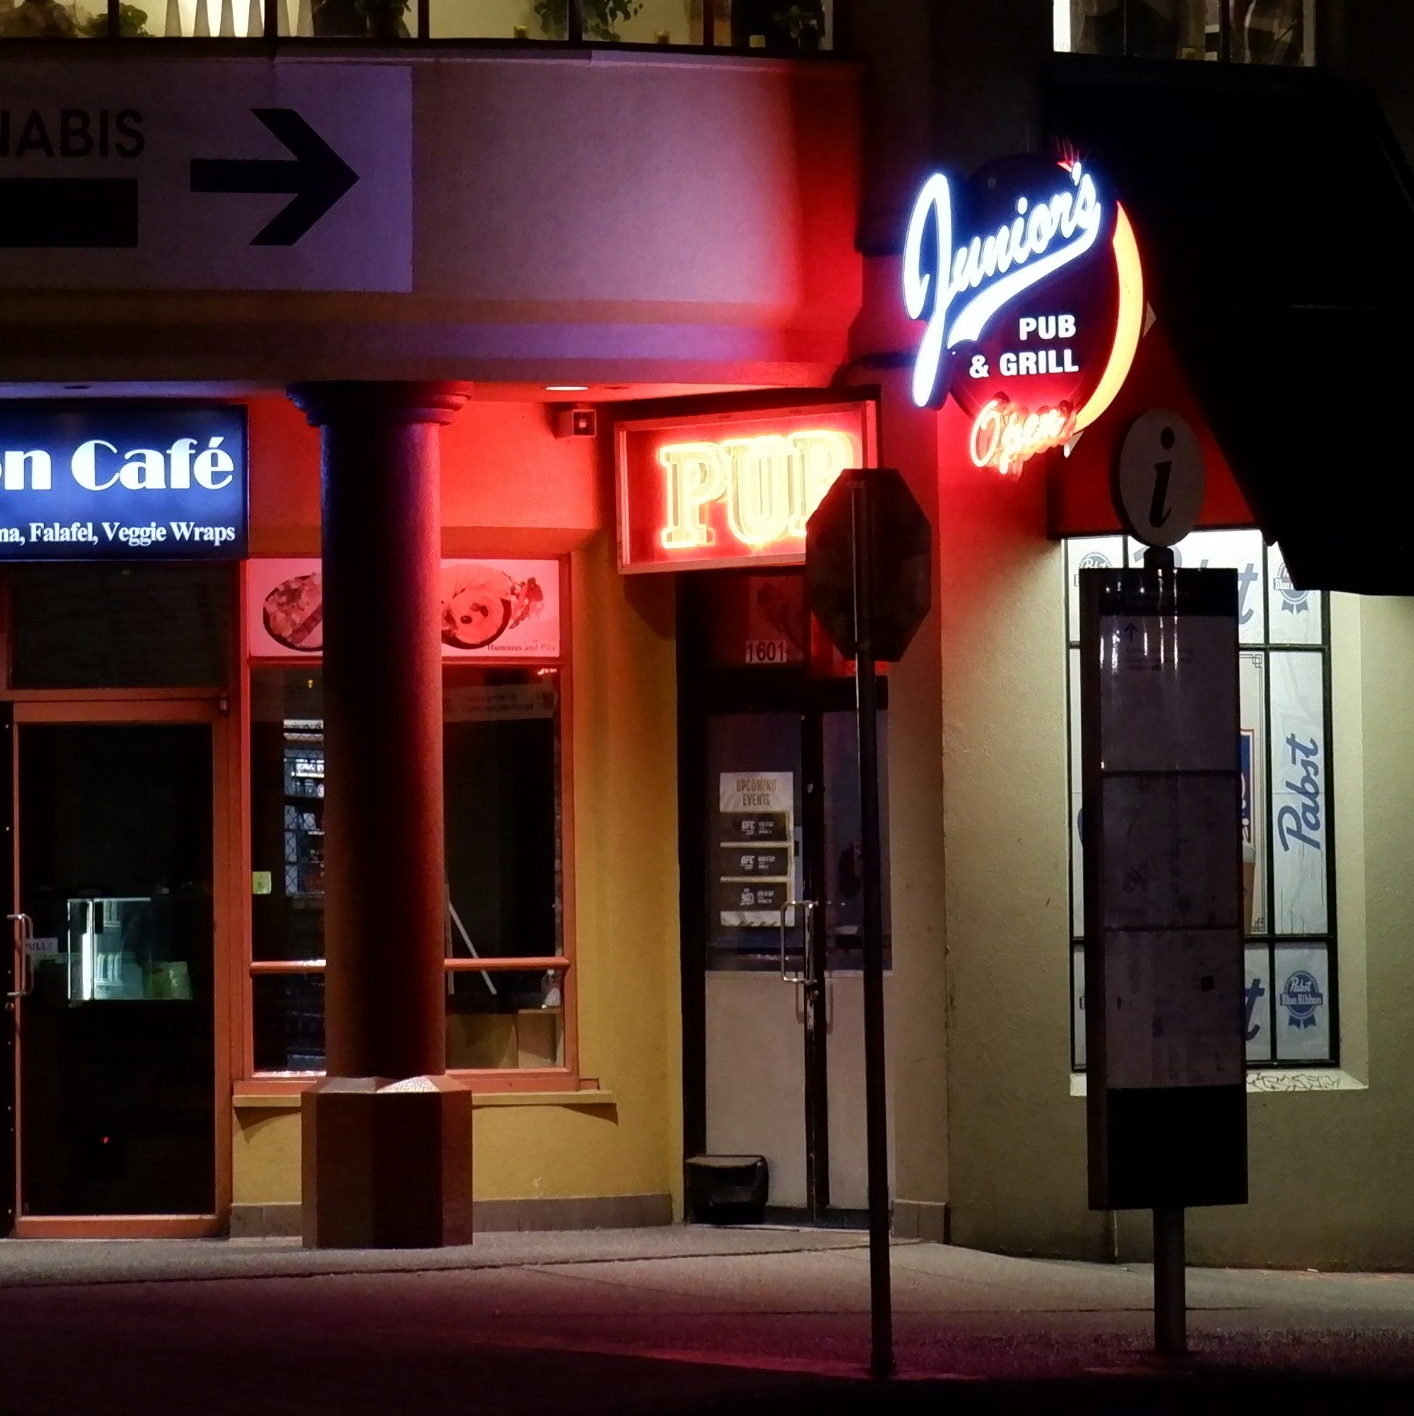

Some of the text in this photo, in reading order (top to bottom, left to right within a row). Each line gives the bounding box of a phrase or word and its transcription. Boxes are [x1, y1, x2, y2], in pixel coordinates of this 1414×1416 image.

[902, 160, 1102, 407] Junior's
[1018, 314, 1076, 341] PUB
[968, 348, 1079, 378] & GRILL
[71, 436, 235, 492] Café
[29, 521, 99, 546] Falafel,
[102, 522, 167, 548] Veggie
[169, 521, 236, 547] Wraps
[487, 643, 523, 652] Hummus
[524, 643, 538, 652] and
[747, 642, 785, 662] 1601
[742, 793, 771, 806] EVENTS
[1277, 732, 1321, 852] Pabst
[1290, 976, 1312, 992] Pabst
